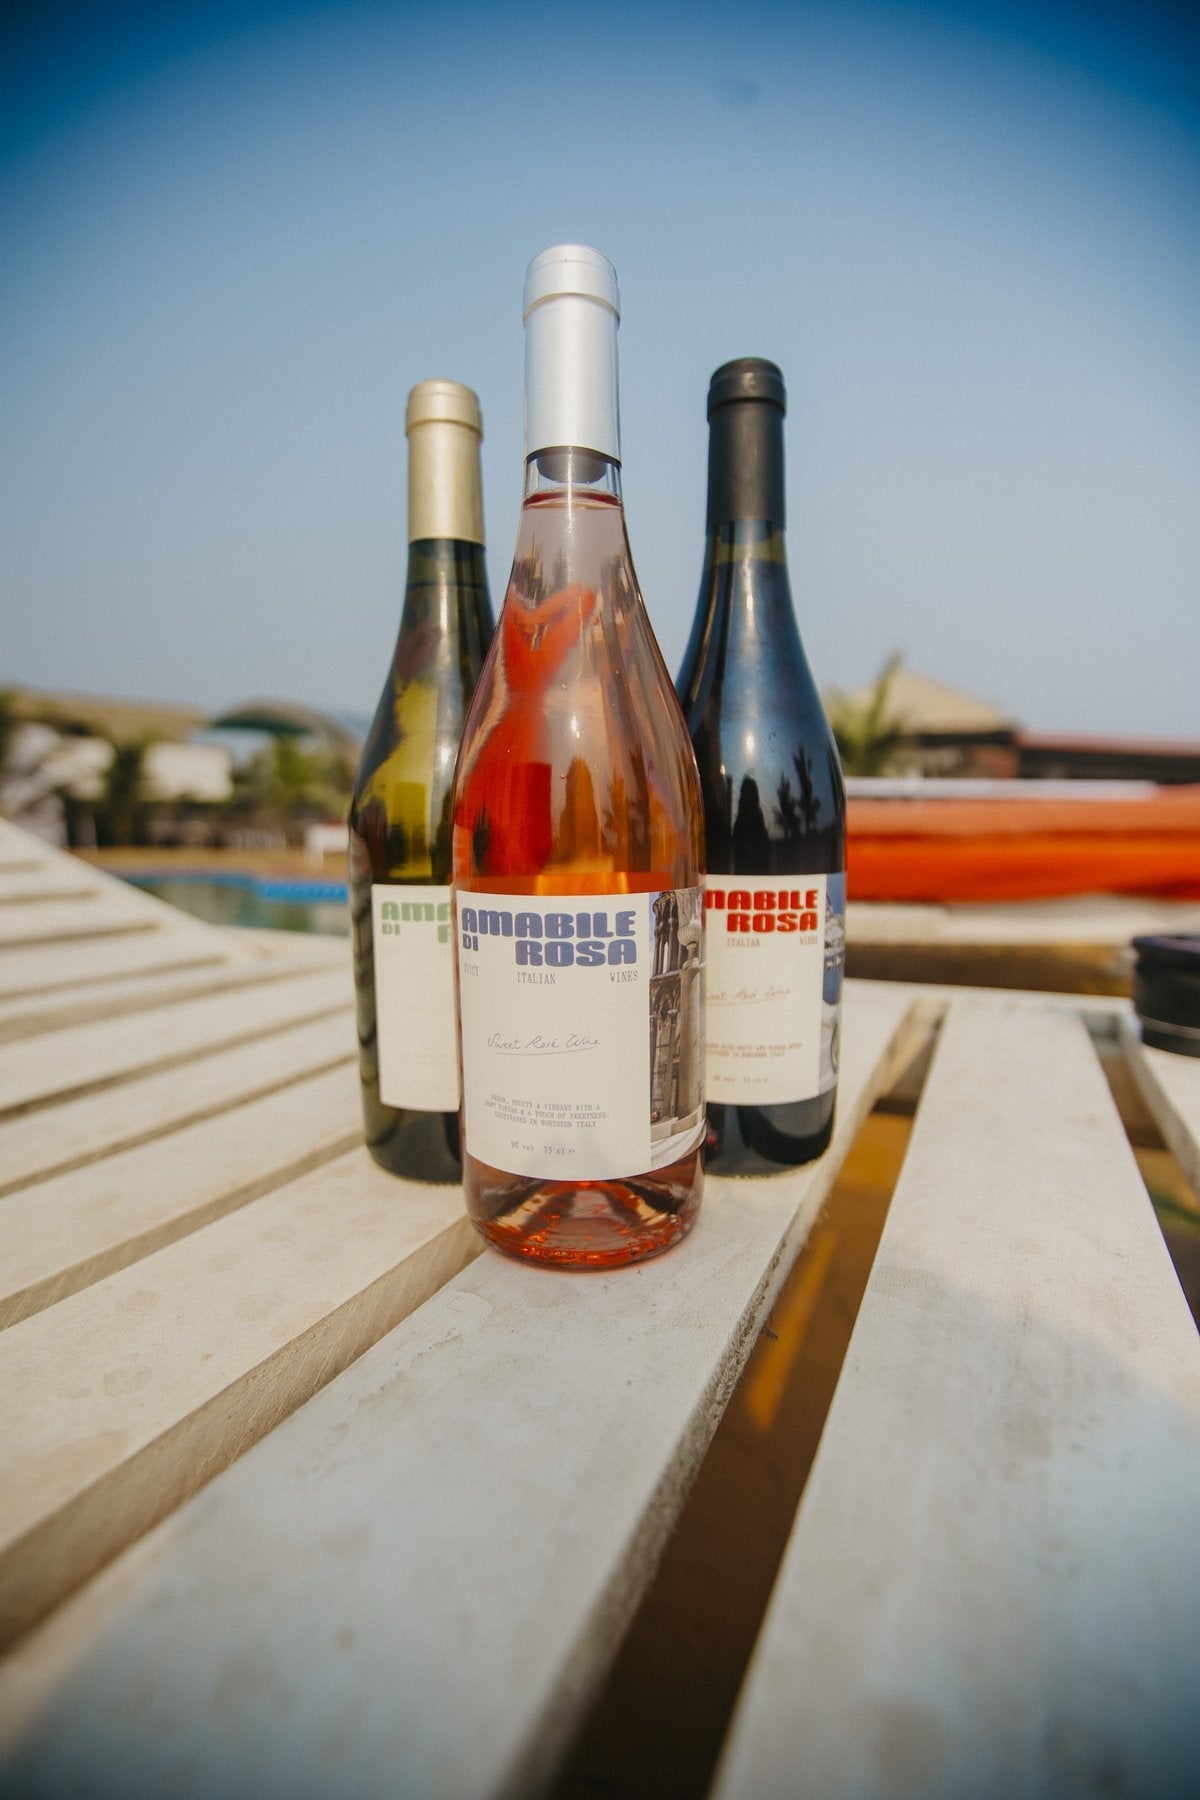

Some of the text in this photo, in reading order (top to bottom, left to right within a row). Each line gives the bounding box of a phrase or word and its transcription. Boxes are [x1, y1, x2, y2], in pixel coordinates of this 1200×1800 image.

[461, 907, 637, 939] AMABILE
[727, 912, 818, 932] ROSA
[381, 923, 400, 935] DI
[727, 936, 760, 948] ITALIAN
[462, 933, 479, 951] DI
[515, 939, 637, 967] ROSA
[516, 972, 556, 985] ITALIAN
[609, 970, 638, 983] WINES
[487, 1032, 521, 1050] Sweet
[565, 1033, 601, 1048] Wine
[544, 1103, 571, 1111] VIBRANT
[557, 1112, 566, 1120] OF
[540, 1119, 572, 1128] NORTHERN
[576, 1120, 596, 1128] ITALY
[521, 1143, 534, 1152] vol
[543, 1146, 553, 1154] 75
